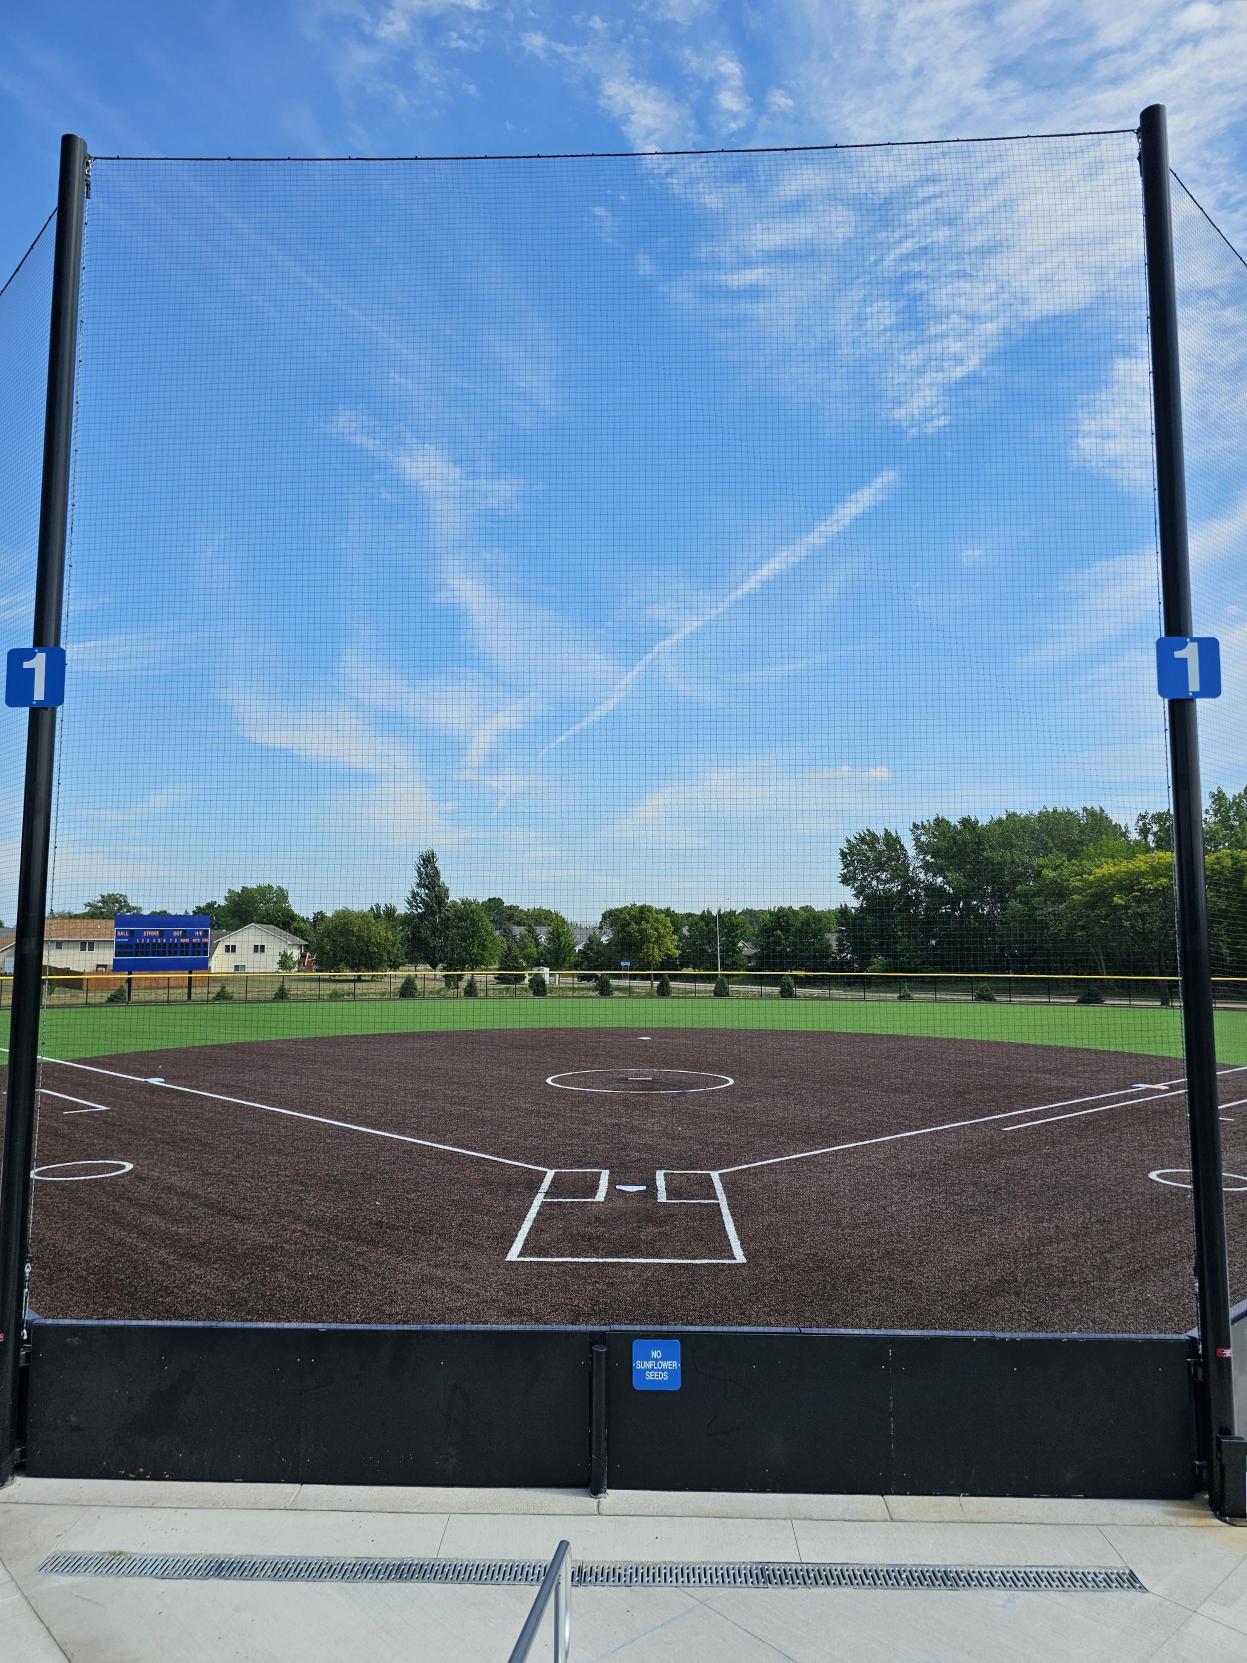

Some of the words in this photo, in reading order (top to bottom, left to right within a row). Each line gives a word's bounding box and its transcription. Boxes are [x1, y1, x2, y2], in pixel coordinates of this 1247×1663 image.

[1174, 642, 1200, 691] 1
[23, 653, 46, 700] 1
[652, 1350, 662, 1358] NO
[636, 1361, 678, 1369] SUNFLOWER
[645, 1371, 669, 1380] SEEDS
